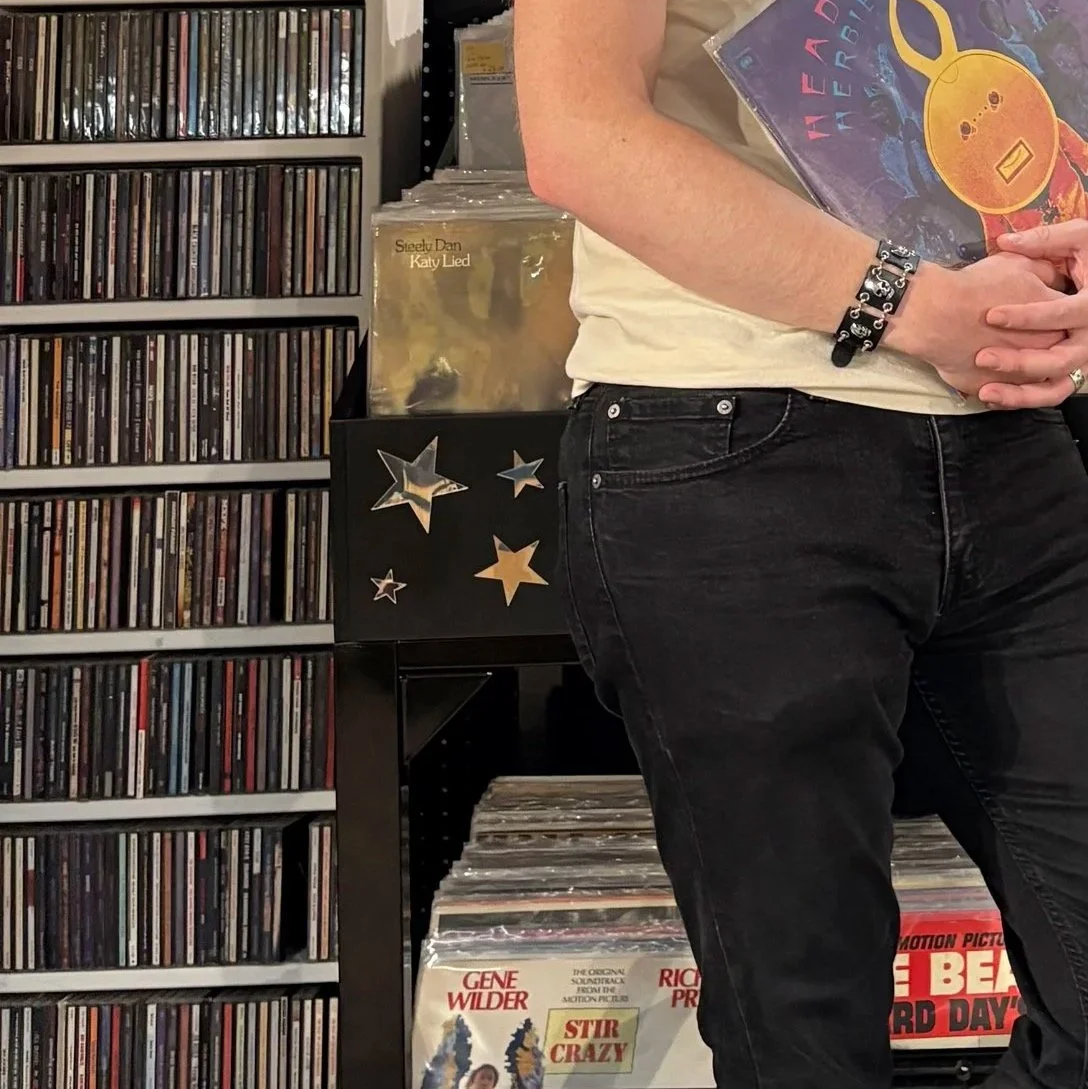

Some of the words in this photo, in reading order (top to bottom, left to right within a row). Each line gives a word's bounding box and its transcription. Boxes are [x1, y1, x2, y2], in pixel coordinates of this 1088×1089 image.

[395, 238, 433, 254] Steely
[435, 238, 462, 252] Dan
[410, 254, 440, 270] Katy
[442, 254, 471, 268] Lied
[899, 934, 957, 951] MOTION
[462, 970, 519, 990] GENE
[588, 968, 626, 976] ORIGINAL
[570, 977, 626, 985] SOUNDTRACK
[576, 986, 599, 994] FROM
[447, 990, 529, 1011] WILDER
[562, 995, 597, 1003] MOTION
[891, 999, 936, 1034] RD
[563, 1018, 620, 1040] STIR
[549, 1043, 630, 1064] CRAZY
